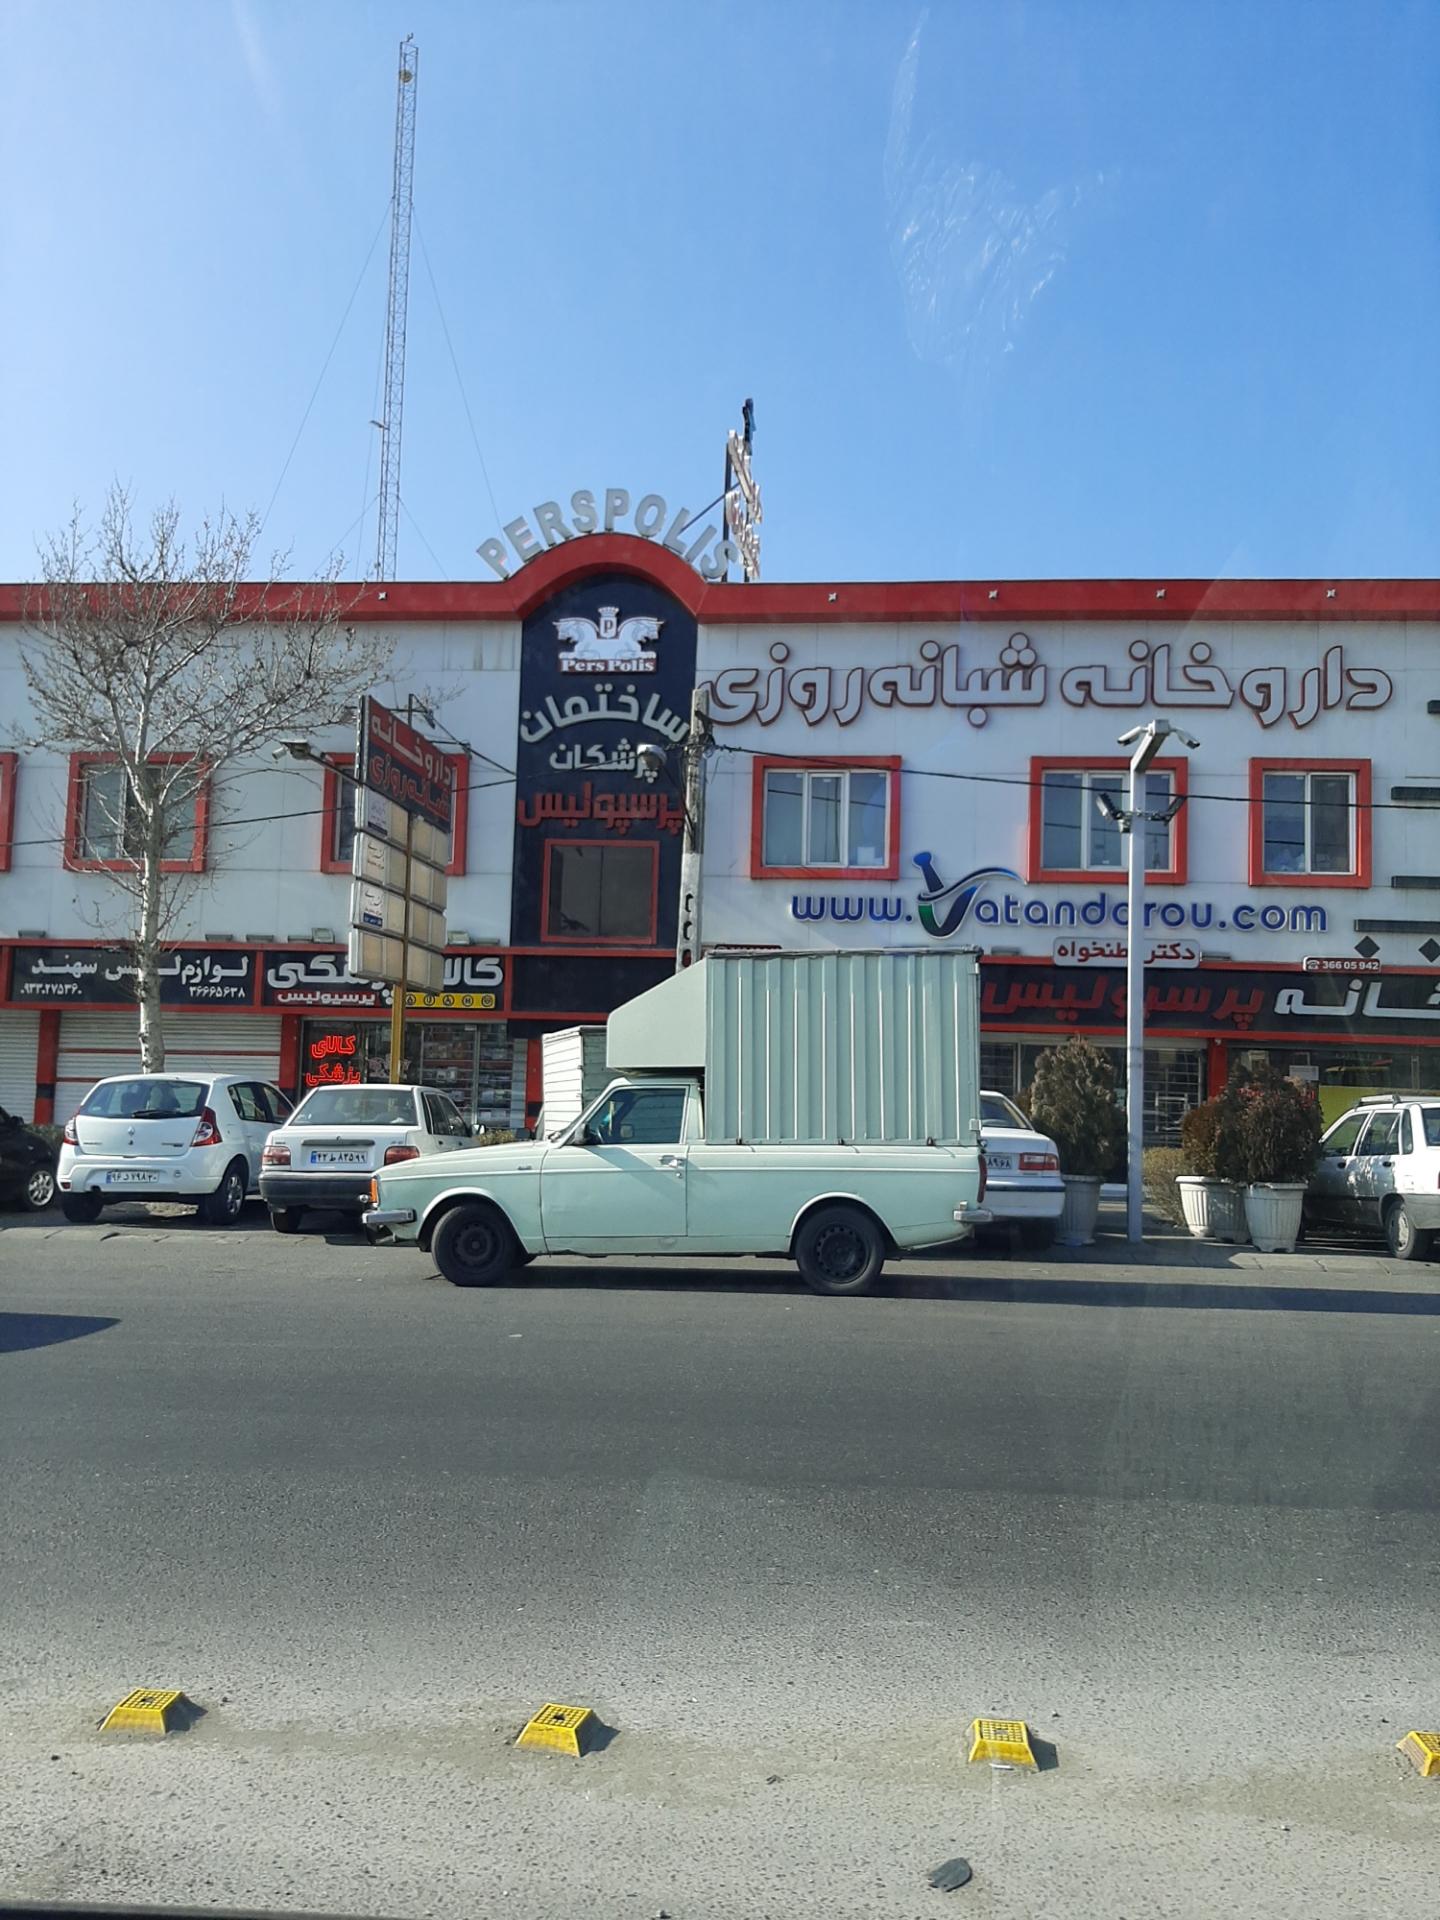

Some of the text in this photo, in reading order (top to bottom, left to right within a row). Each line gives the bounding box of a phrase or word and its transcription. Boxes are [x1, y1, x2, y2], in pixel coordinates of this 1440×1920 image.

[476, 488, 738, 580] PERSPOLIS
[1060, 640, 1393, 729] داروخانه
[520, 683, 690, 743] ساختمان
[371, 715, 451, 786] داروخانه
[517, 781, 686, 835] پرسپولیس
[31, 955, 98, 978] سهند
[1056, 941, 1196, 964] دکتر طنخواه
[1322, 961, 1379, 970] 366 05 942
[181, 954, 248, 985] لوازم
[277, 990, 376, 1005] پرسپولیس
[310, 1034, 357, 1059] کالای
[305, 1062, 361, 1086] پزشکی
